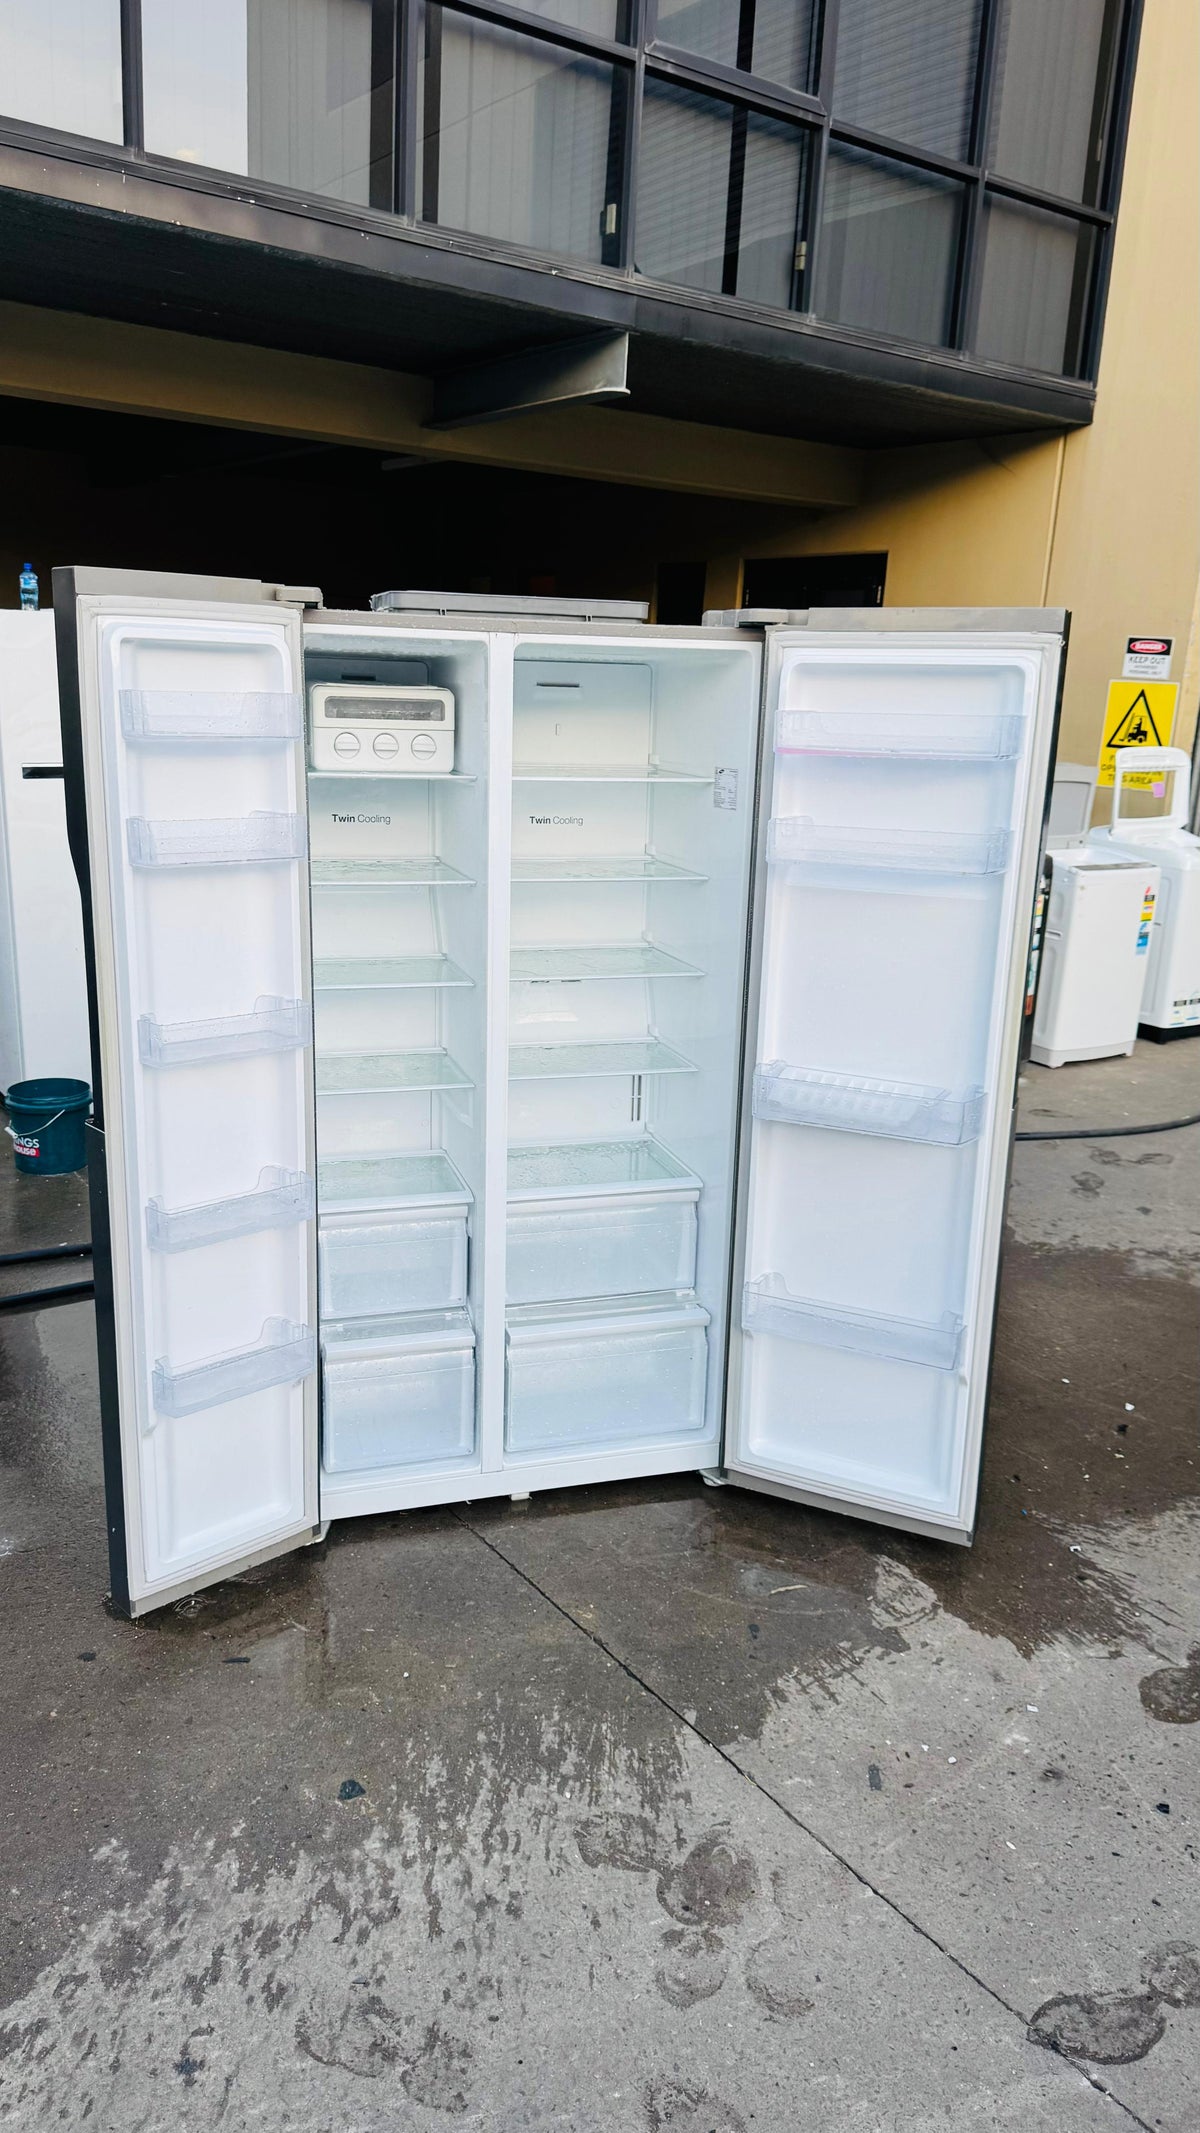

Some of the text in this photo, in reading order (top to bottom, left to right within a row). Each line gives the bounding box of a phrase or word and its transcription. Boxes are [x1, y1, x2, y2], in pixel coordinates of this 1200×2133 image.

[331, 813, 391, 826] Twin Cooling
[529, 815, 584, 827] Twin Cooling
